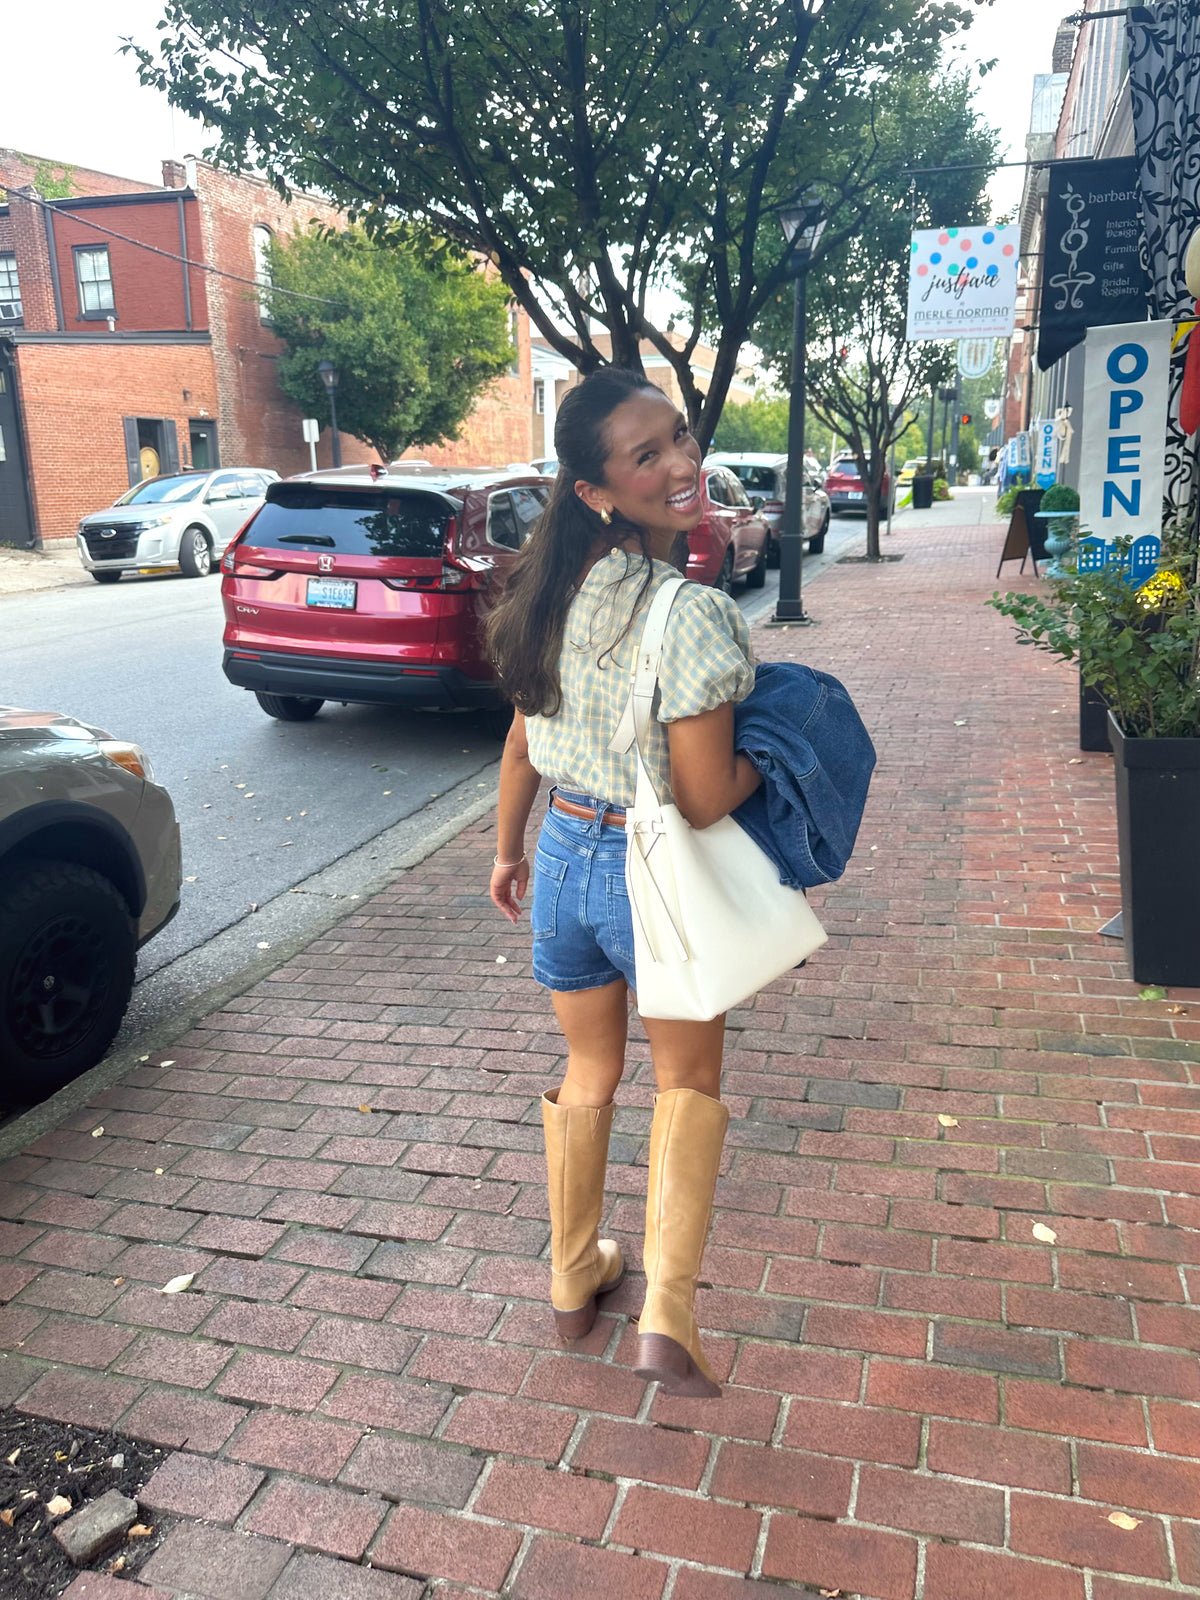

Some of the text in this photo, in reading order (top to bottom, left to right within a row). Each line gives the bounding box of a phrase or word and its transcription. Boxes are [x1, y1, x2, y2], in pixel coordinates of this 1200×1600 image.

[1106, 228, 1137, 239] Design
[1102, 261, 1124, 272] Gifts
[1102, 277, 1130, 288] Bridal
[1101, 286, 1139, 297] Registry
[914, 306, 1009, 320] MERLE NORMAN
[1102, 343, 1149, 517] OPEN
[1042, 424, 1053, 468] OPEN
[322, 586, 353, 601] S1E695
